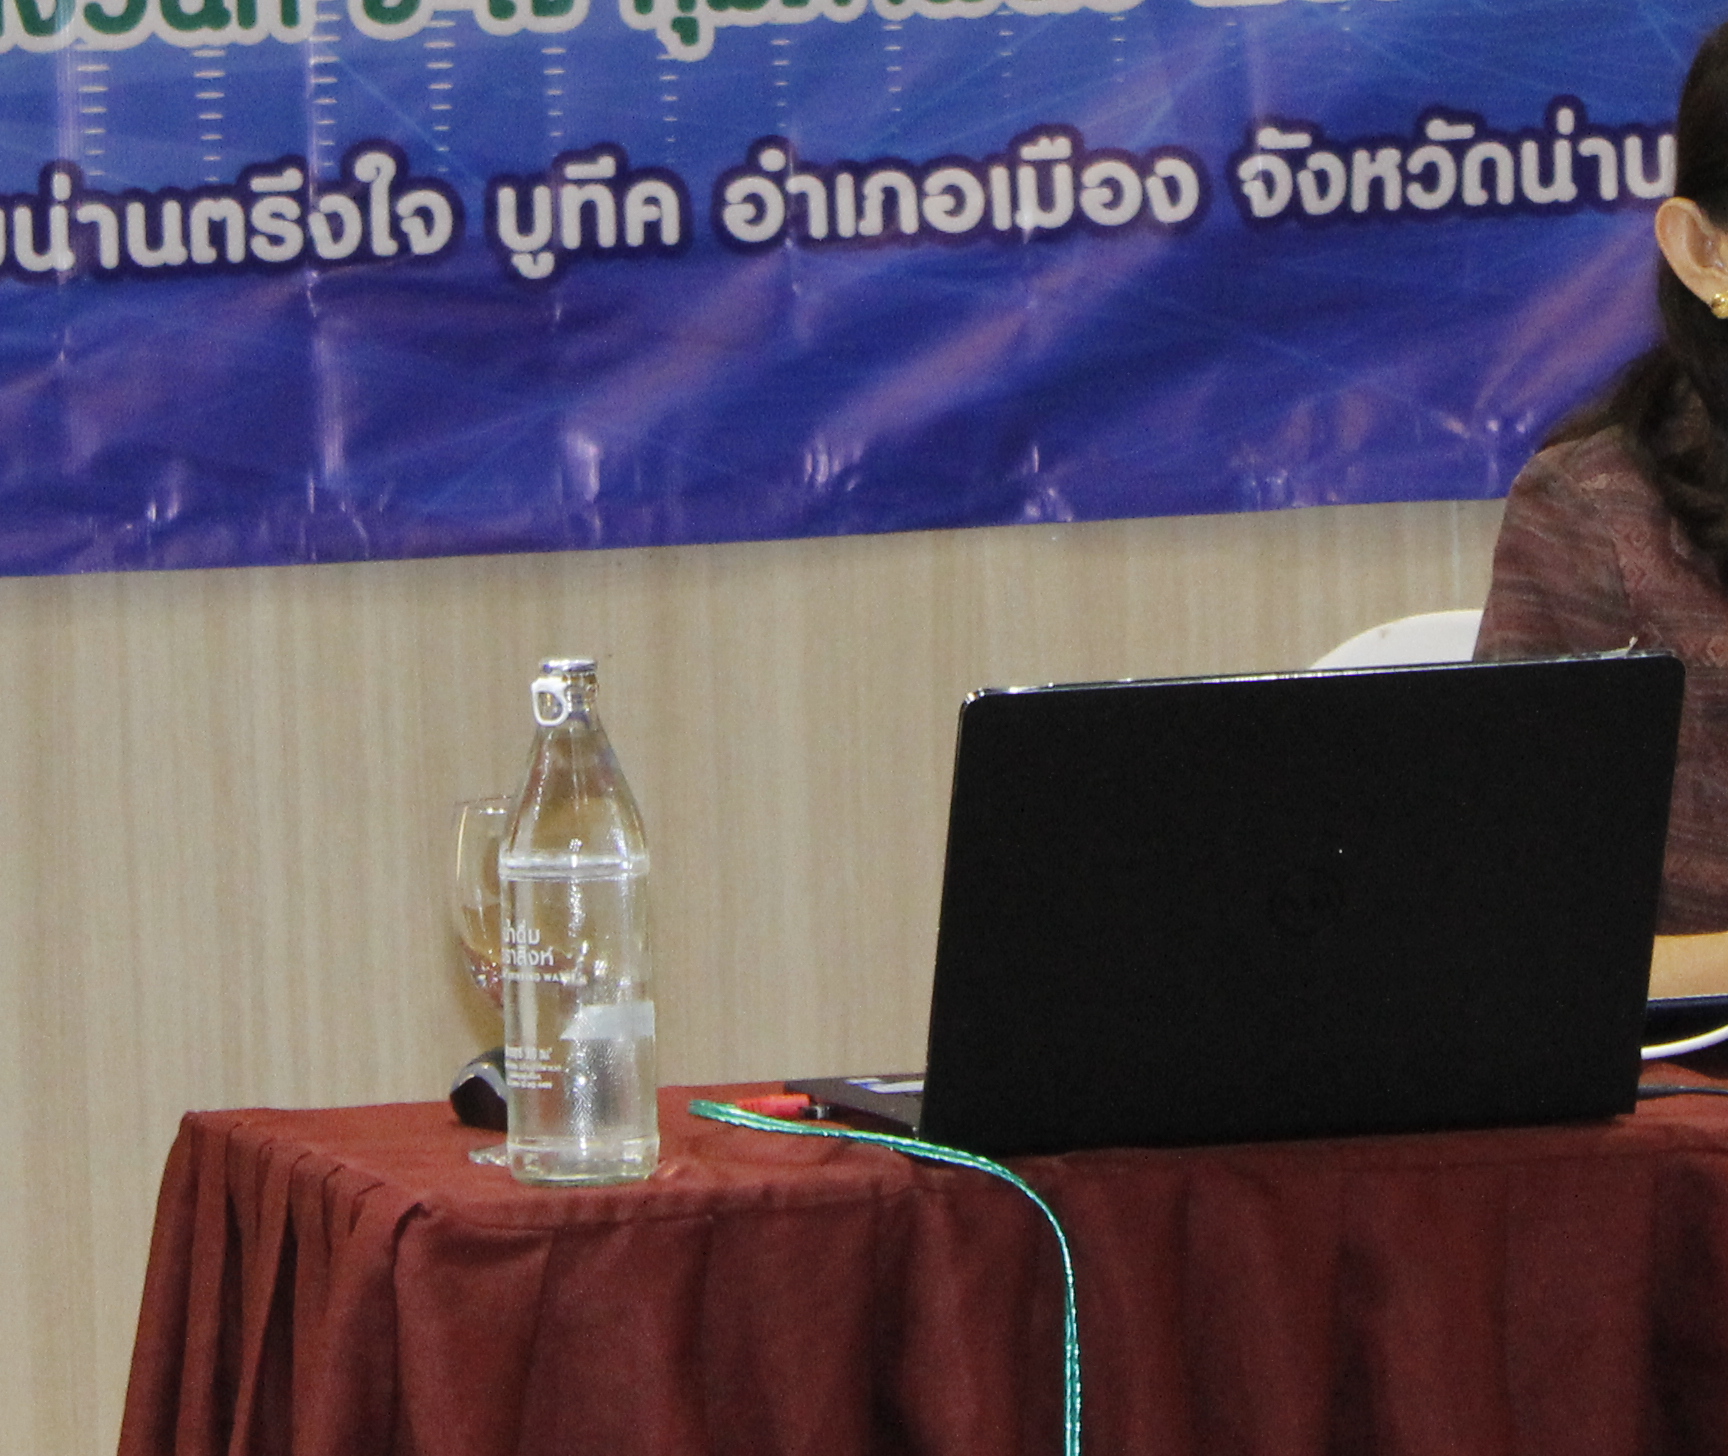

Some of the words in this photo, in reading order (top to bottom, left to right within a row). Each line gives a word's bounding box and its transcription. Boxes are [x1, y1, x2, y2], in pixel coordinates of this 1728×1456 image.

[496, 154, 681, 280] บูทีค
[722, 134, 1200, 243] อำเภอเมือง
